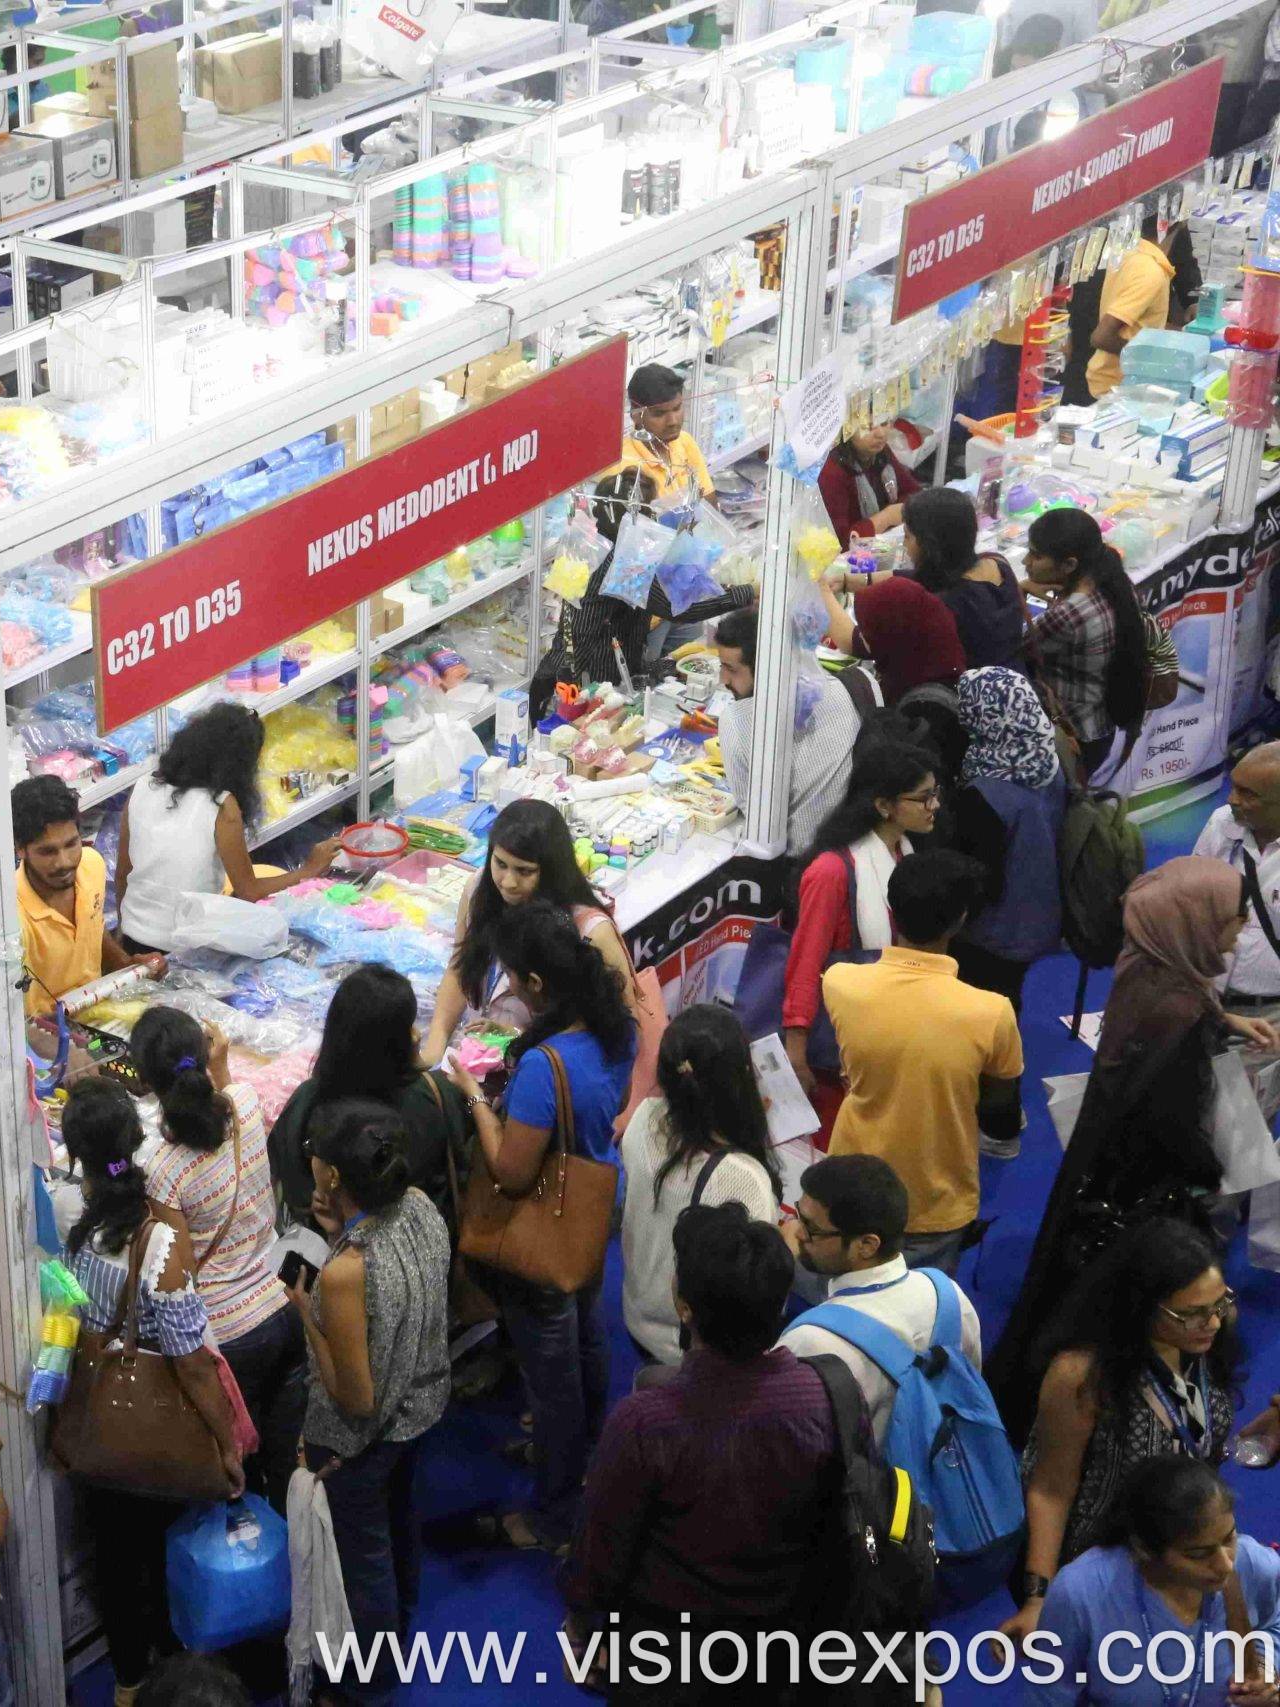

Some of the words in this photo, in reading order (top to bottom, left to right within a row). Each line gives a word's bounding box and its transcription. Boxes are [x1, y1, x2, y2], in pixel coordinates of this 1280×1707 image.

[382, 10, 419, 38] Colgate
[906, 241, 936, 278] C32
[937, 230, 955, 261] TO
[956, 214, 985, 252] D35
[1032, 173, 1073, 214] NEXUS
[1137, 118, 1174, 158] (NMD)
[107, 622, 155, 676] C32
[160, 605, 190, 649] TO
[195, 580, 242, 634] D35
[308, 514, 373, 576] NEXUS
[377, 459, 479, 541] MEDODENT
[1157, 721, 1176, 734] Hand
[1178, 717, 1199, 729] Piece
